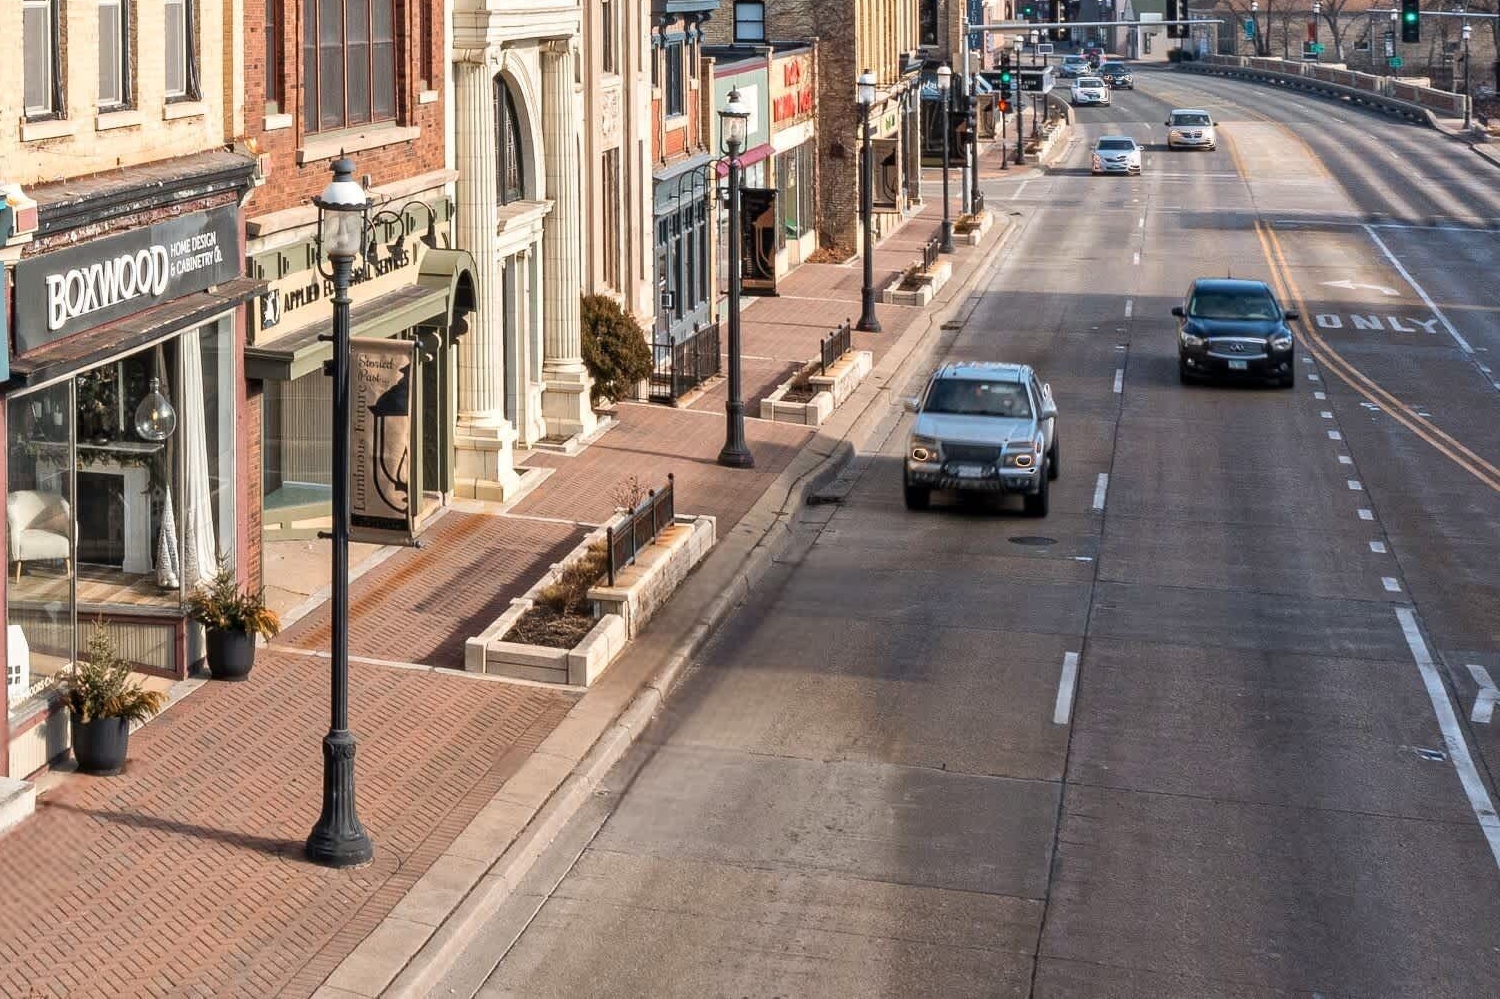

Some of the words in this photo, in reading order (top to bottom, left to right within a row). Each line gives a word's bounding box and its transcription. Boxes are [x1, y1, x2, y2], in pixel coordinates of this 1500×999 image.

[170, 239, 191, 257] HOME
[191, 231, 217, 251] DESIGN
[170, 262, 176, 277] &
[176, 250, 214, 275] CABINETRY
[46, 244, 169, 330] BOXWOOD
[283, 281, 320, 314] APPLIED
[1315, 313, 1439, 334] ONLY
[358, 354, 394, 371] Storied
[354, 385, 367, 433] Future
[354, 438, 366, 513] Luminous
